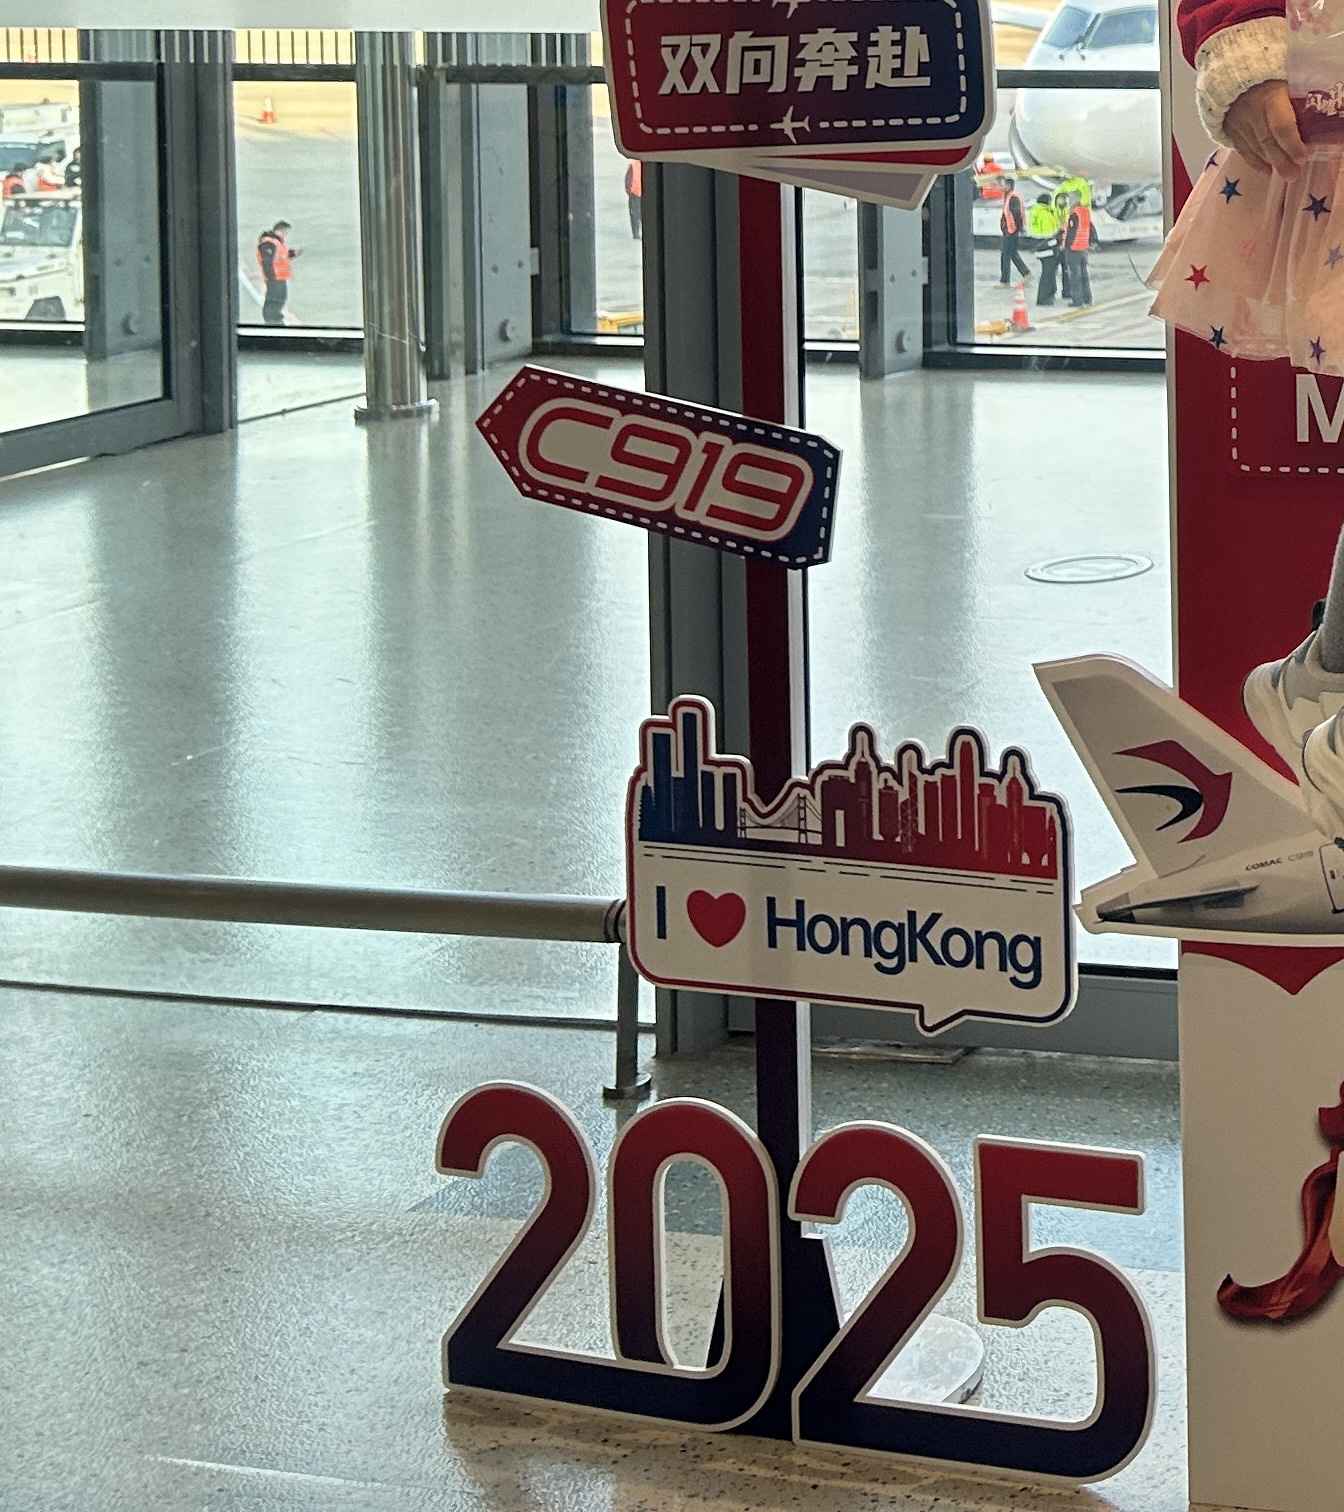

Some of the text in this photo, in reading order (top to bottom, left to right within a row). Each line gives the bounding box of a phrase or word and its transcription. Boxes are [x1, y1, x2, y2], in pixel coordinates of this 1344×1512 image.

[657, 25, 934, 97] 双向奔赴
[522, 402, 810, 536] C919
[655, 885, 1042, 993] I HongKong
[434, 1079, 1157, 1484] 2025
